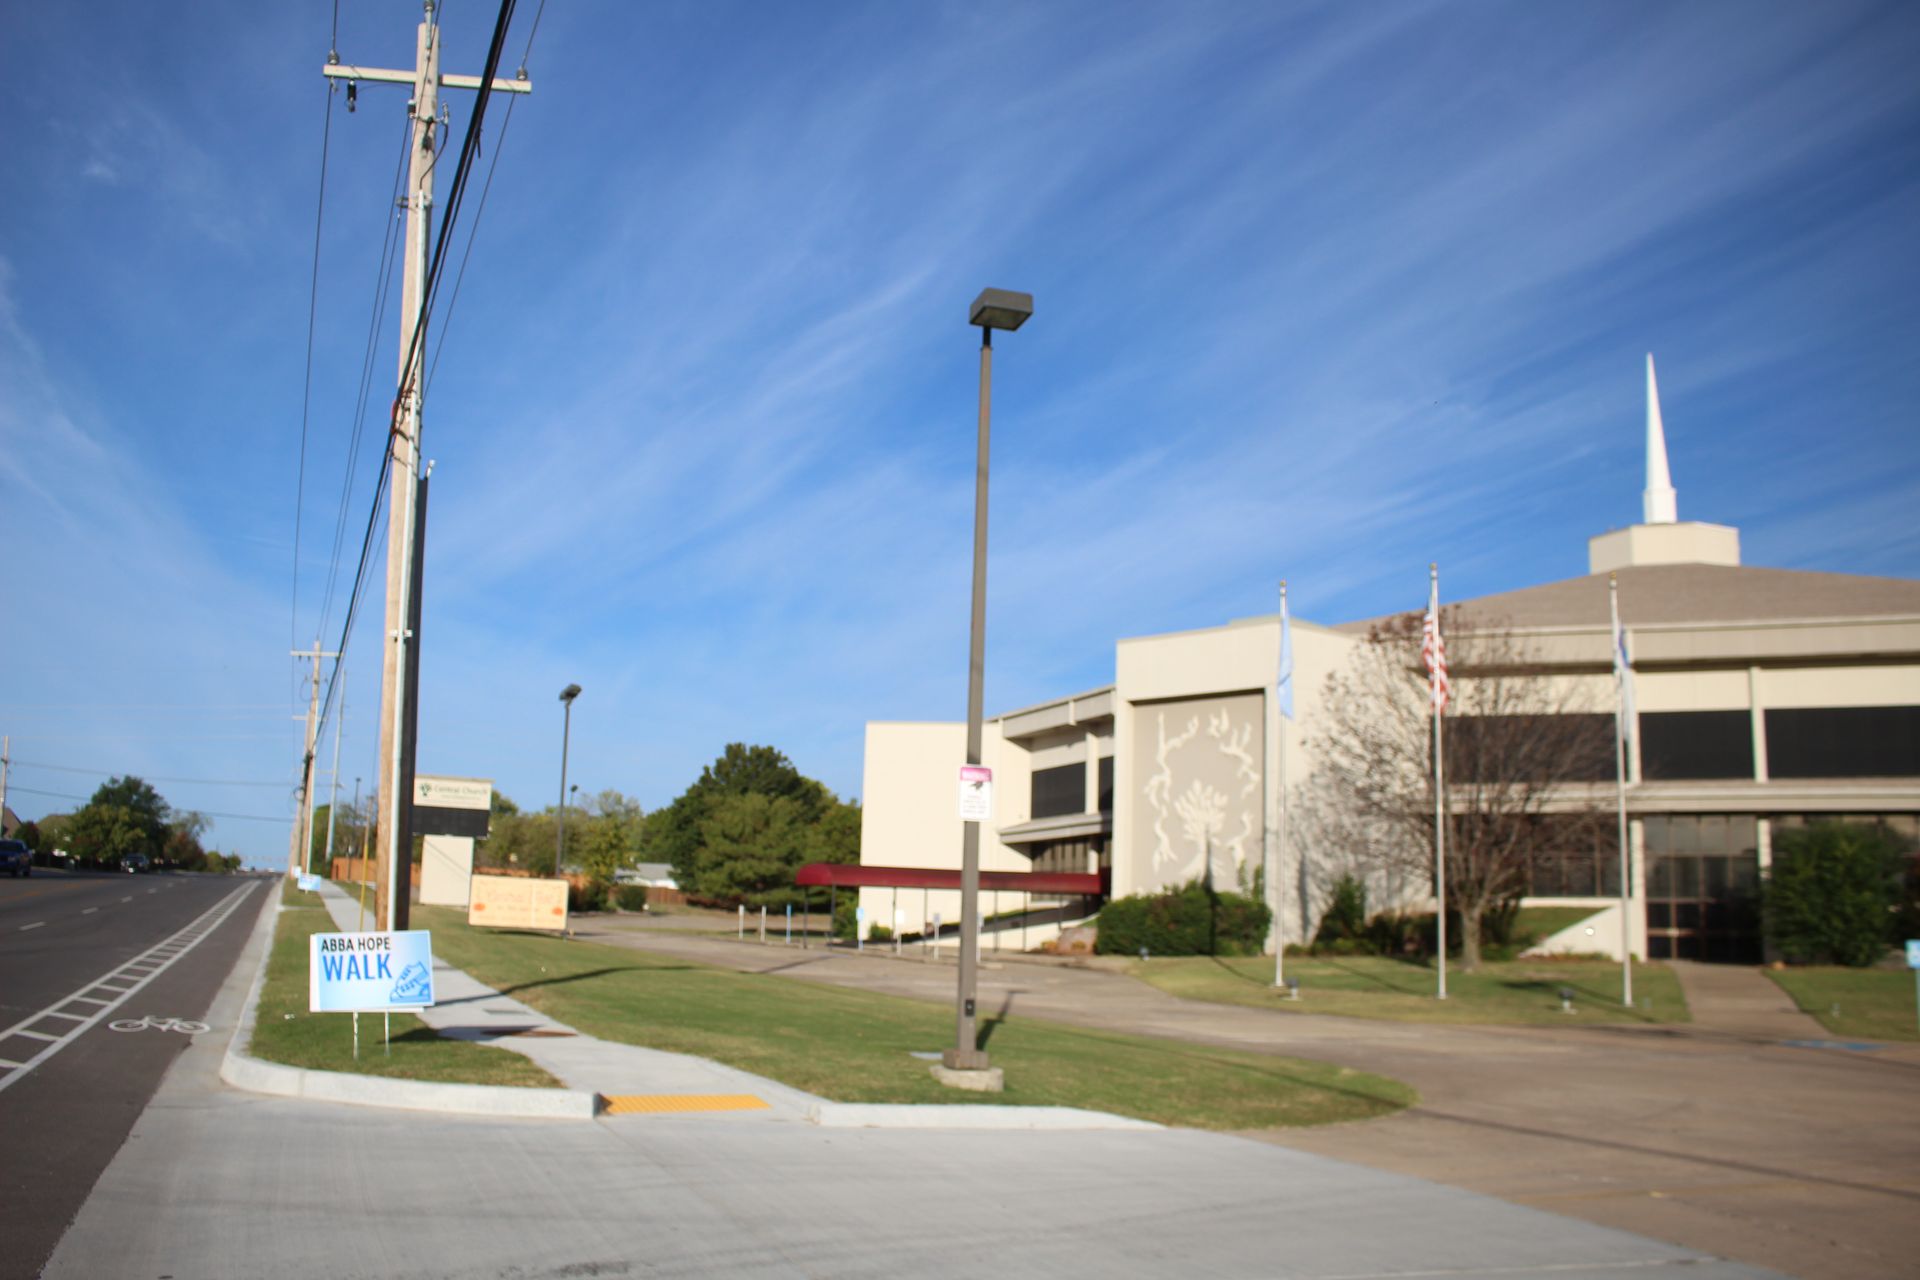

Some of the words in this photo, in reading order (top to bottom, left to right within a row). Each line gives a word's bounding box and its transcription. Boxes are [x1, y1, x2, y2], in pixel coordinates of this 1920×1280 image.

[322, 938, 354, 951] ABBA
[358, 937, 391, 950] HOPE
[322, 954, 392, 981] WALK
